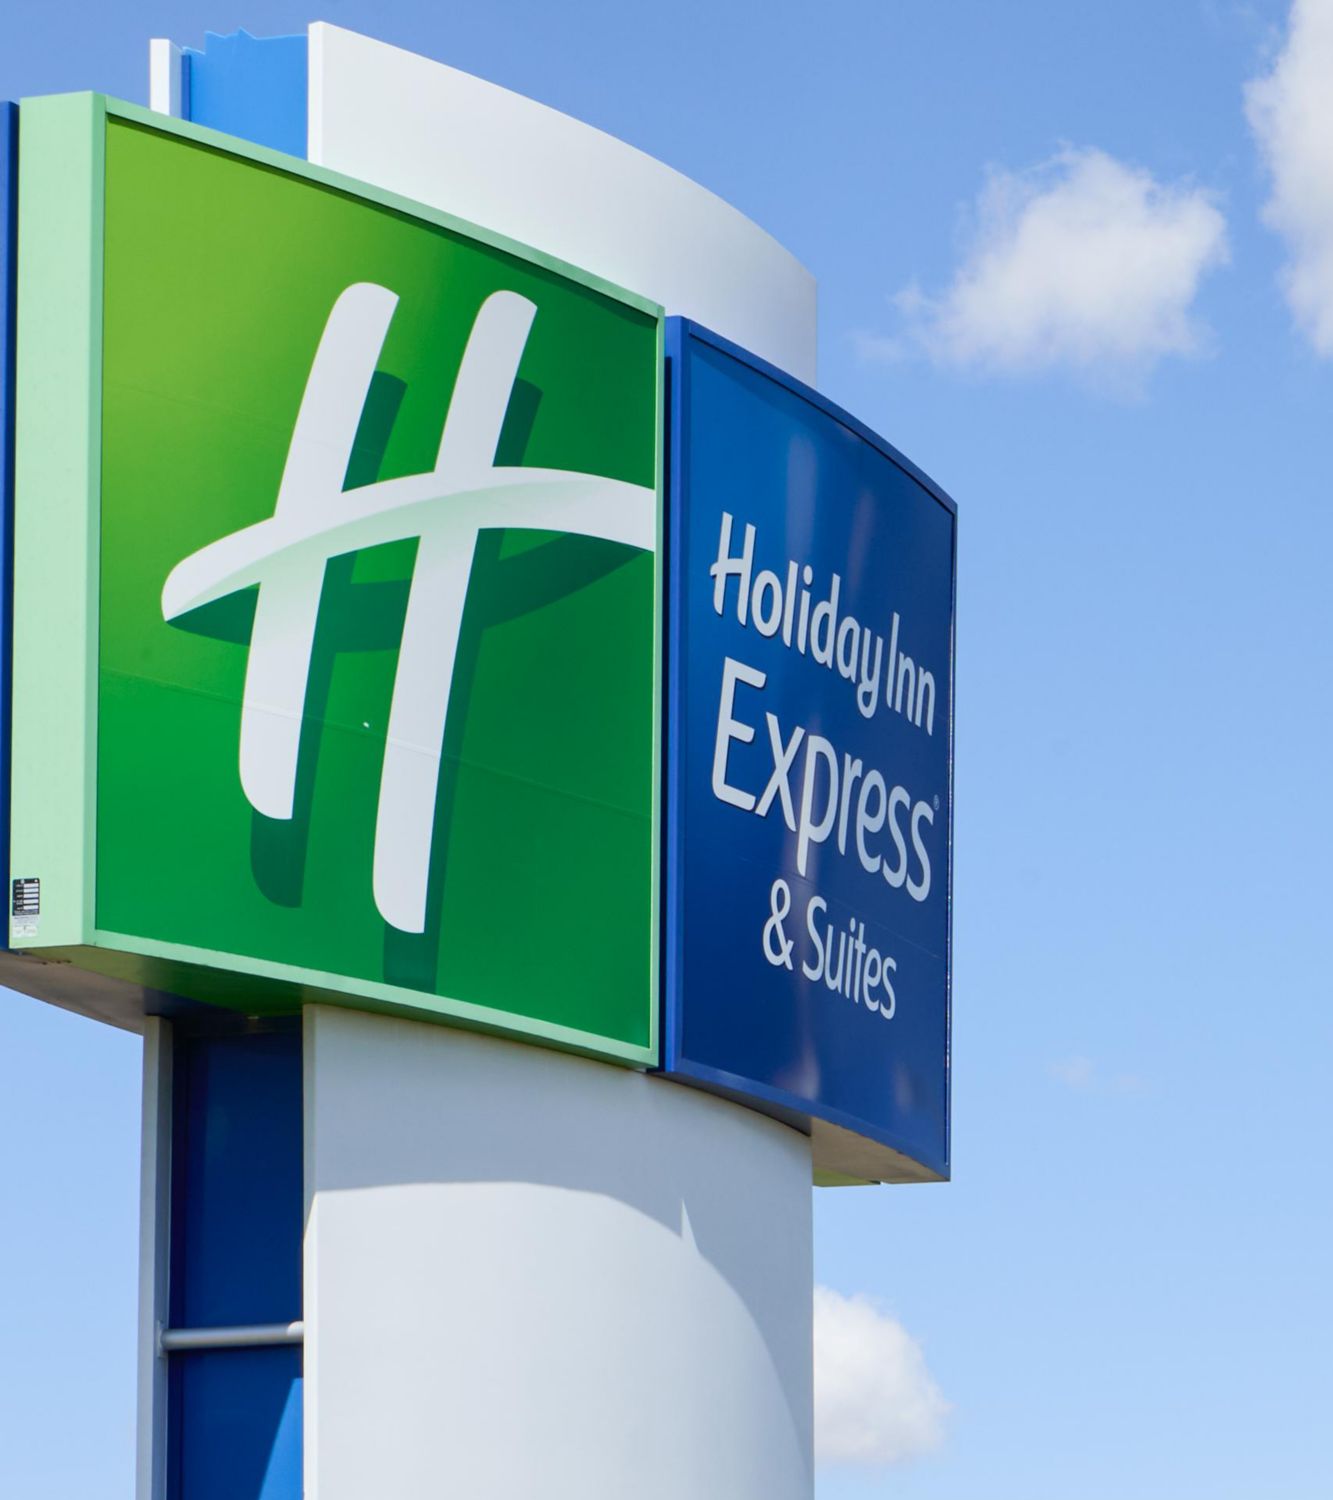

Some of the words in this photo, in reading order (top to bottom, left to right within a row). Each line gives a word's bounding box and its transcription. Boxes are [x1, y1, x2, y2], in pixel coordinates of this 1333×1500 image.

[709, 510, 883, 718] Holiday
[886, 611, 935, 736] Inn
[711, 656, 934, 902] Express
[762, 878, 795, 971] &
[802, 895, 897, 1020] Suites
